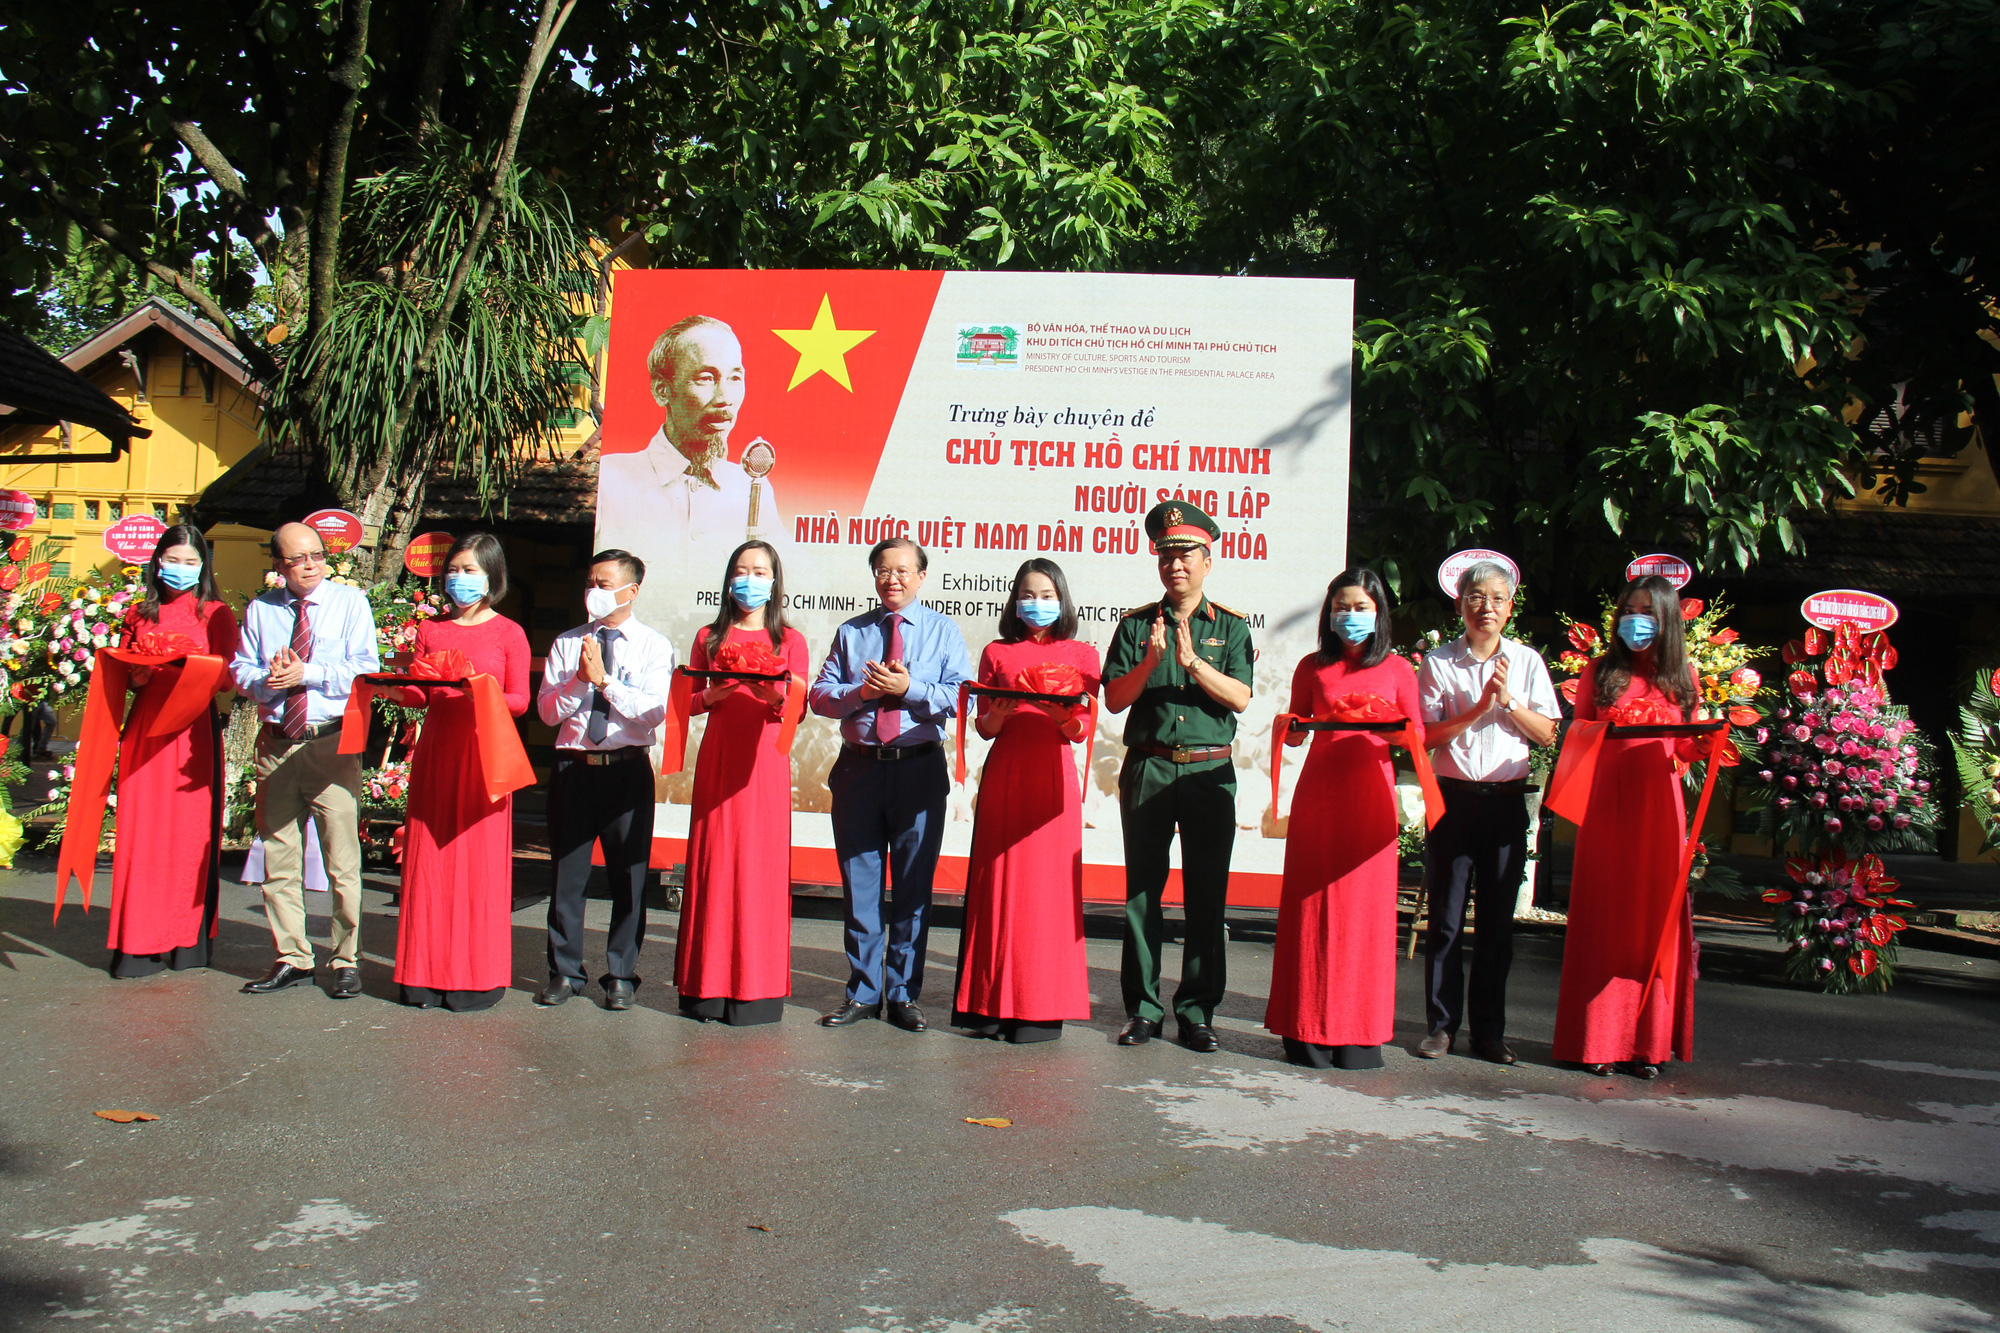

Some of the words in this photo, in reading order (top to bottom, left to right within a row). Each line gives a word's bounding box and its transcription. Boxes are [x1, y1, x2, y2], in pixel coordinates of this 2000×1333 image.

[1028, 322, 1041, 334] BỘ
[1043, 322, 1062, 333] VĂN
[1064, 323, 1088, 334] HÓA,
[1090, 322, 1109, 334] THỂ
[1110, 326, 1136, 334] THAO
[1138, 324, 1150, 335] VÀ
[1153, 326, 1167, 336] DU
[1170, 327, 1191, 338] LỊCH
[1026, 338, 1046, 347] KHU
[1049, 338, 1059, 347] DI
[1061, 337, 1082, 348] TÍCH
[1084, 336, 1105, 348] CHỦ
[1106, 340, 1128, 350] TỊCH
[1147, 339, 1164, 350] CHÍ
[1166, 341, 1191, 350] MINH
[1194, 342, 1208, 352] TẠI
[1210, 340, 1230, 352] PHỦ
[1232, 342, 1253, 352] CHỦ
[1255, 344, 1277, 355] TỊCH
[1026, 352, 1060, 360] MINISTRY
[1074, 353, 1108, 362] CULTURE,
[1110, 354, 1138, 362] SPORTS
[1157, 356, 1191, 364] TOURISM
[1025, 364, 1064, 373] PRESIDENT
[1065, 365, 1077, 374] HO
[1078, 366, 1091, 374] CHI
[1119, 367, 1148, 376] VESTIGE
[1159, 368, 1173, 376] THE
[1174, 369, 1225, 378] PRESIDENTIAL
[1226, 370, 1254, 379] PALACE
[1255, 372, 1275, 380] AREA
[949, 404, 1009, 428] Trưng
[1013, 406, 1049, 428] bày
[1053, 406, 1124, 430] chuyên
[1130, 406, 1156, 428] đề
[946, 432, 1002, 465] CHỦ
[1010, 440, 1076, 471] TỊCH
[1084, 432, 1122, 469] HỒ
[1132, 440, 1180, 472] CHÍ
[1188, 446, 1271, 475] MINH
[1074, 481, 1146, 514] NGƯỜI
[1227, 486, 1270, 524] LẬP
[795, 512, 840, 544] NHÀ
[848, 514, 910, 545] NƯỚC
[918, 516, 966, 554] VIỆT
[974, 522, 1028, 551] NAM
[1038, 520, 1083, 552] DÂN
[1092, 520, 1139, 555] CHỦ
[1221, 526, 1268, 560] HÒA
[793, 594, 816, 610] CHI
[818, 595, 855, 611] MINH
[867, 598, 882, 611] TH
[965, 601, 984, 616] OF
[986, 602, 1004, 617] TH
[1816, 617, 1841, 626] CHÚC
